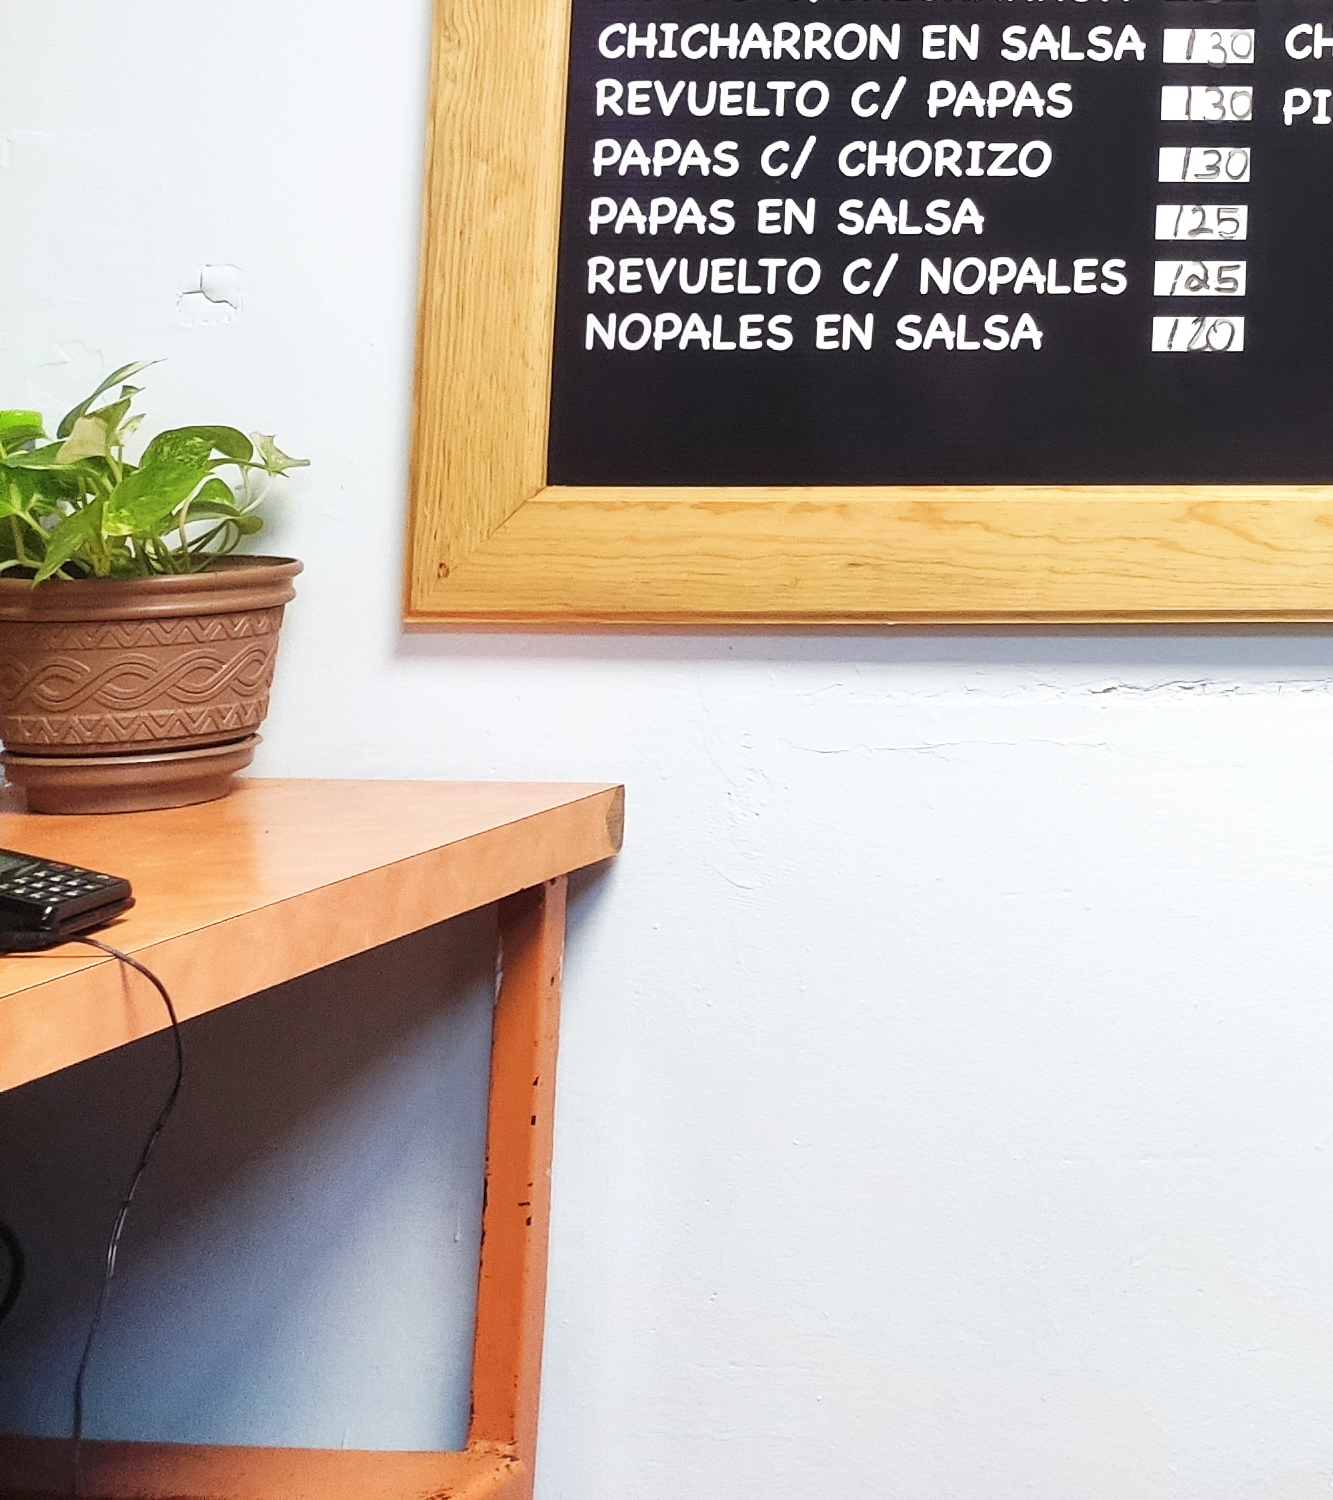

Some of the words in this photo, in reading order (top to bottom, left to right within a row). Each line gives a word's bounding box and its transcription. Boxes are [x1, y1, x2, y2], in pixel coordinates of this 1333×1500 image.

[599, 22, 900, 60] CHICHARRON
[921, 24, 979, 61] EN
[1001, 24, 1146, 61] SALSA
[1186, 29, 1252, 68] 130
[596, 78, 829, 117] REVUELTO
[851, 76, 906, 119] C/
[927, 80, 1072, 118] PAPAS
[1185, 86, 1253, 123] 130
[593, 139, 739, 177] PAPAS
[761, 135, 816, 179] C/
[839, 139, 1052, 177] CHORIZO
[1182, 147, 1248, 180] 130
[589, 197, 735, 235] PAPAS
[758, 198, 815, 234] EN
[838, 198, 984, 235] SALSA
[1173, 205, 1240, 239] 125
[588, 256, 821, 294] REVUELTO
[843, 253, 898, 297] C/
[920, 257, 1127, 295] NOPALES
[1170, 261, 1241, 296] 125
[586, 313, 793, 350] NOPALES
[816, 313, 873, 350] EN
[896, 313, 1043, 350] SALSA
[1167, 317, 1235, 350] 120
